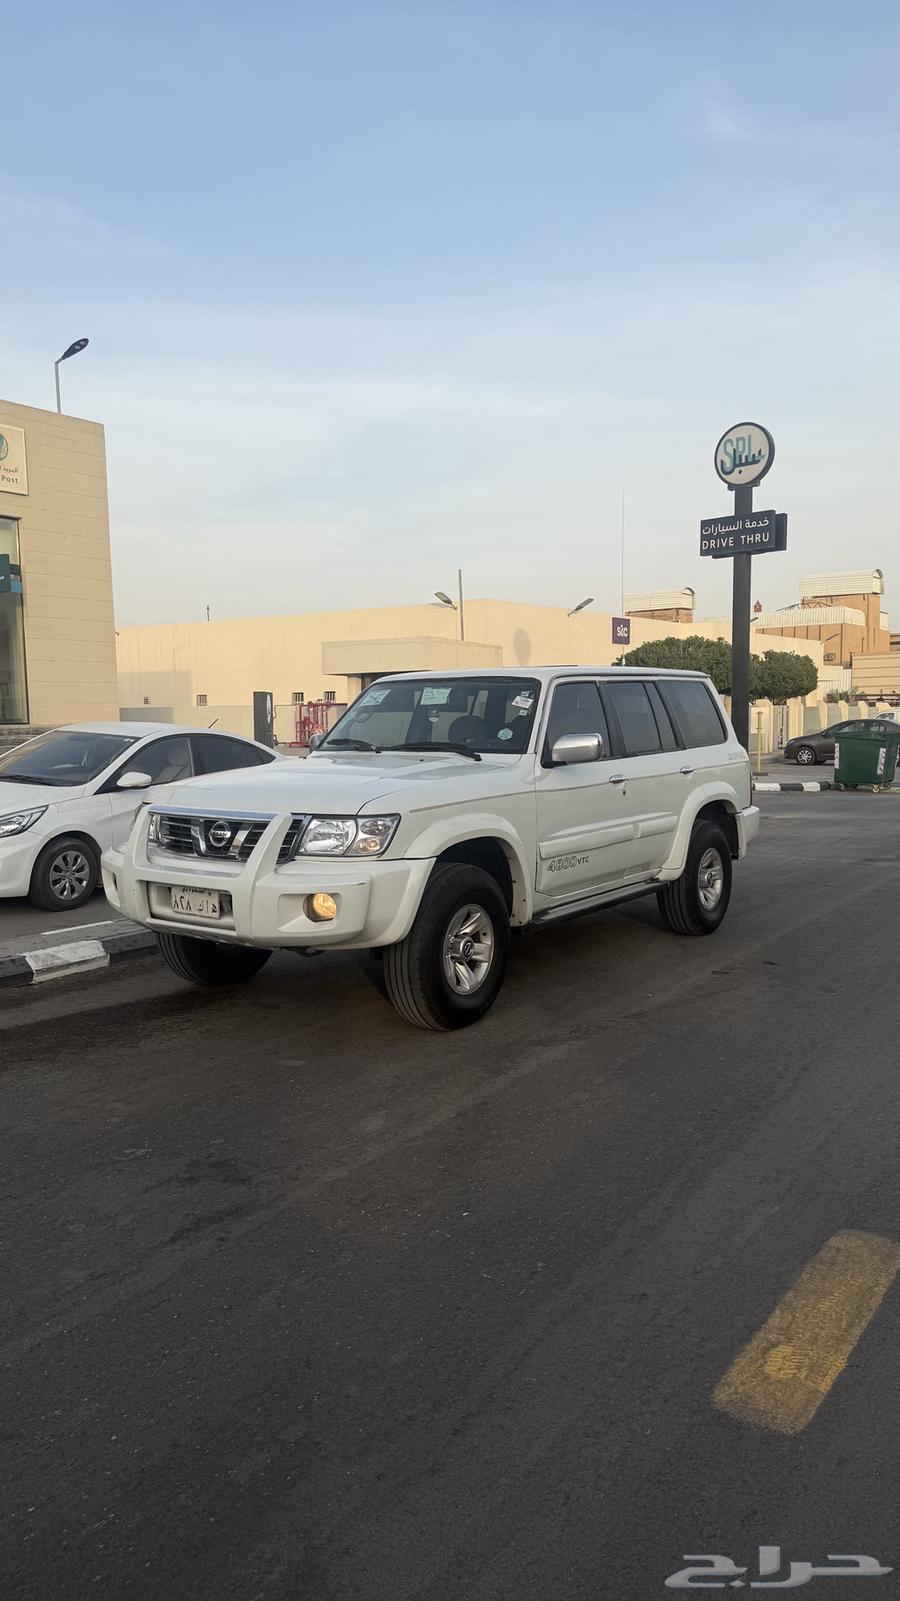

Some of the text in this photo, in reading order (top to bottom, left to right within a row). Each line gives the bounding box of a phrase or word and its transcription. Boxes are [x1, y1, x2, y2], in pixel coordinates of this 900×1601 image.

[723, 434, 752, 468] SPL
[1, 474, 18, 484] Post
[702, 516, 770, 536] خدمة السيارات
[702, 531, 770, 551] DRIVE THRU
[547, 855, 577, 872] 4800
